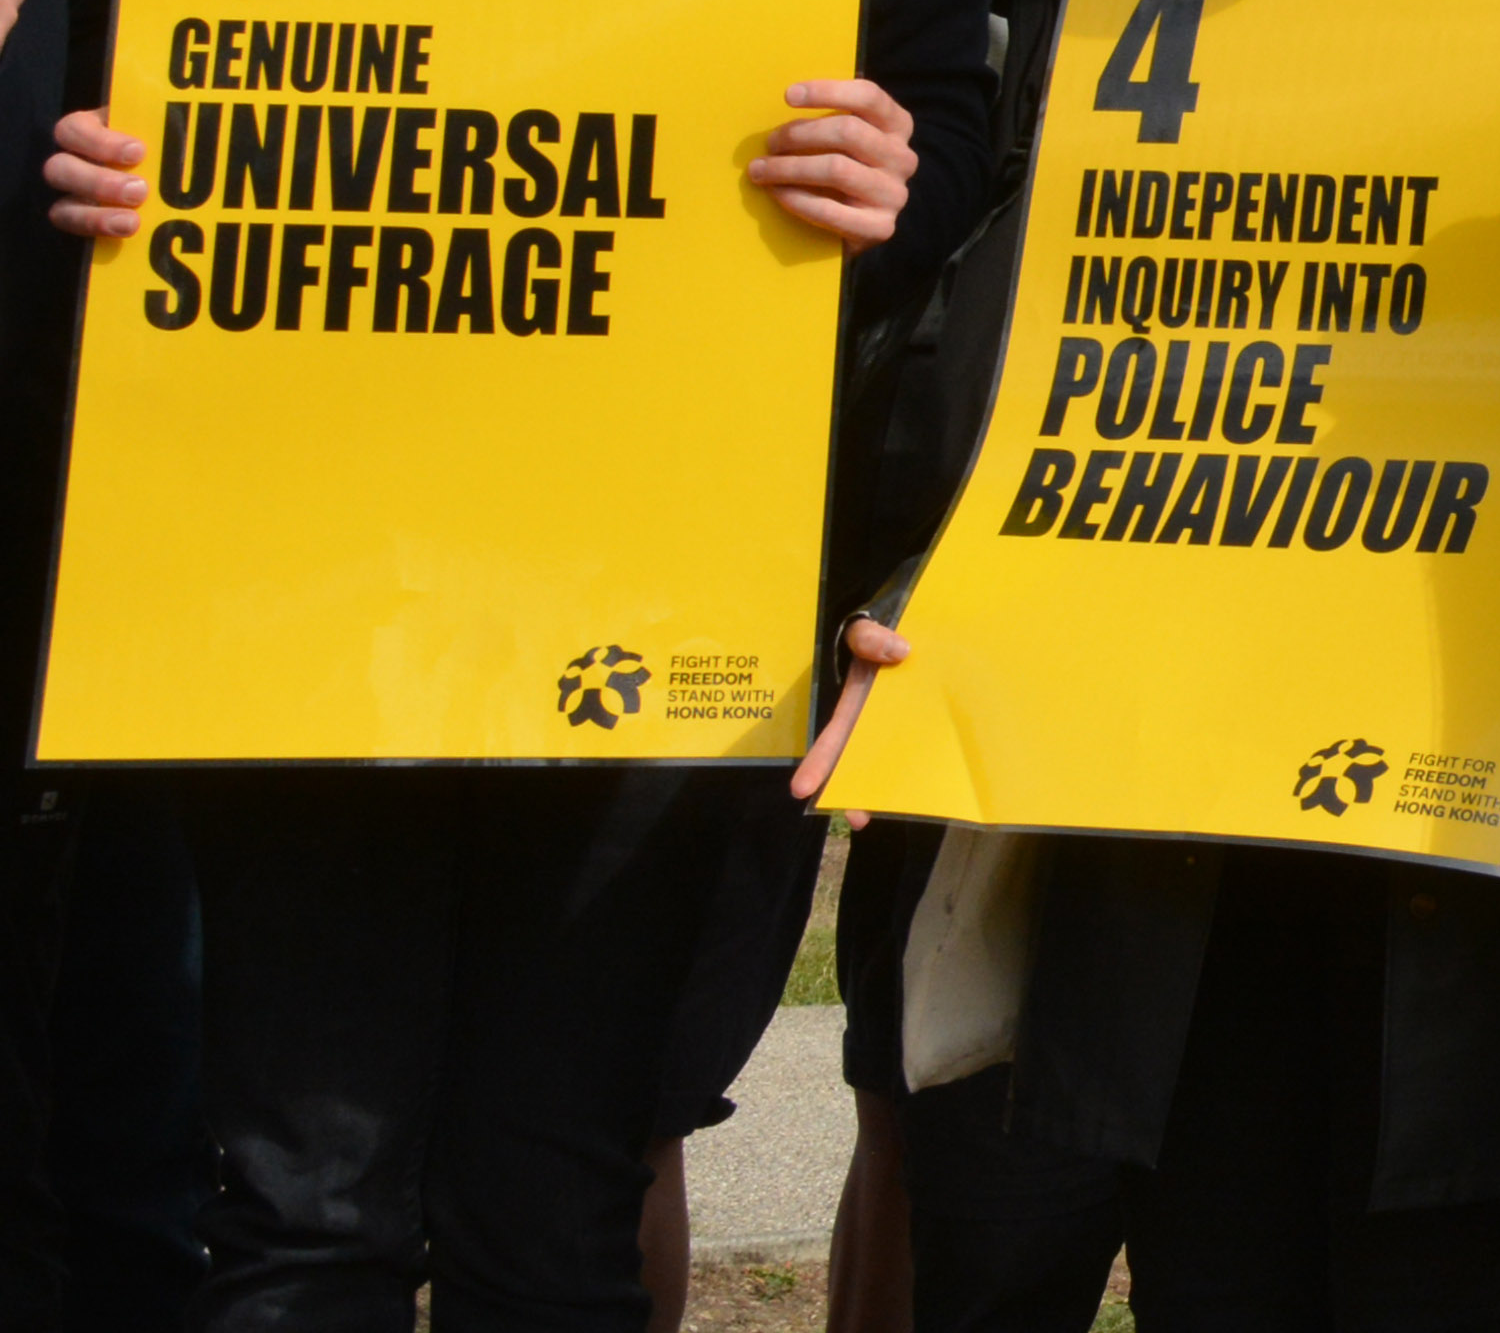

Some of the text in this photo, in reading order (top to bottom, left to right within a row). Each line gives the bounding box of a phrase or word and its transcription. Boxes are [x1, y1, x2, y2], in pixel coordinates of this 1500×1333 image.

[169, 17, 433, 95] GENUINE
[157, 102, 666, 219] UNIVERSAL
[1075, 169, 1438, 246] INDEPENDENT
[144, 220, 615, 336] SUFFRAGE
[1062, 255, 1427, 336] INQUIRY INTO
[1038, 337, 1332, 445] POLICE
[998, 448, 1490, 555] BEHAVIOUR
[671, 656, 759, 668] FIGHT FOR
[669, 673, 752, 685] FREEDOM
[668, 690, 774, 702] STAND WITH
[666, 707, 772, 719] HONG KONG
[1409, 752, 1496, 773] FIGHT FOR
[1404, 768, 1487, 789] FREEDOM
[1399, 784, 1456, 802] STAND
[1394, 800, 1499, 826] HONG KONG
